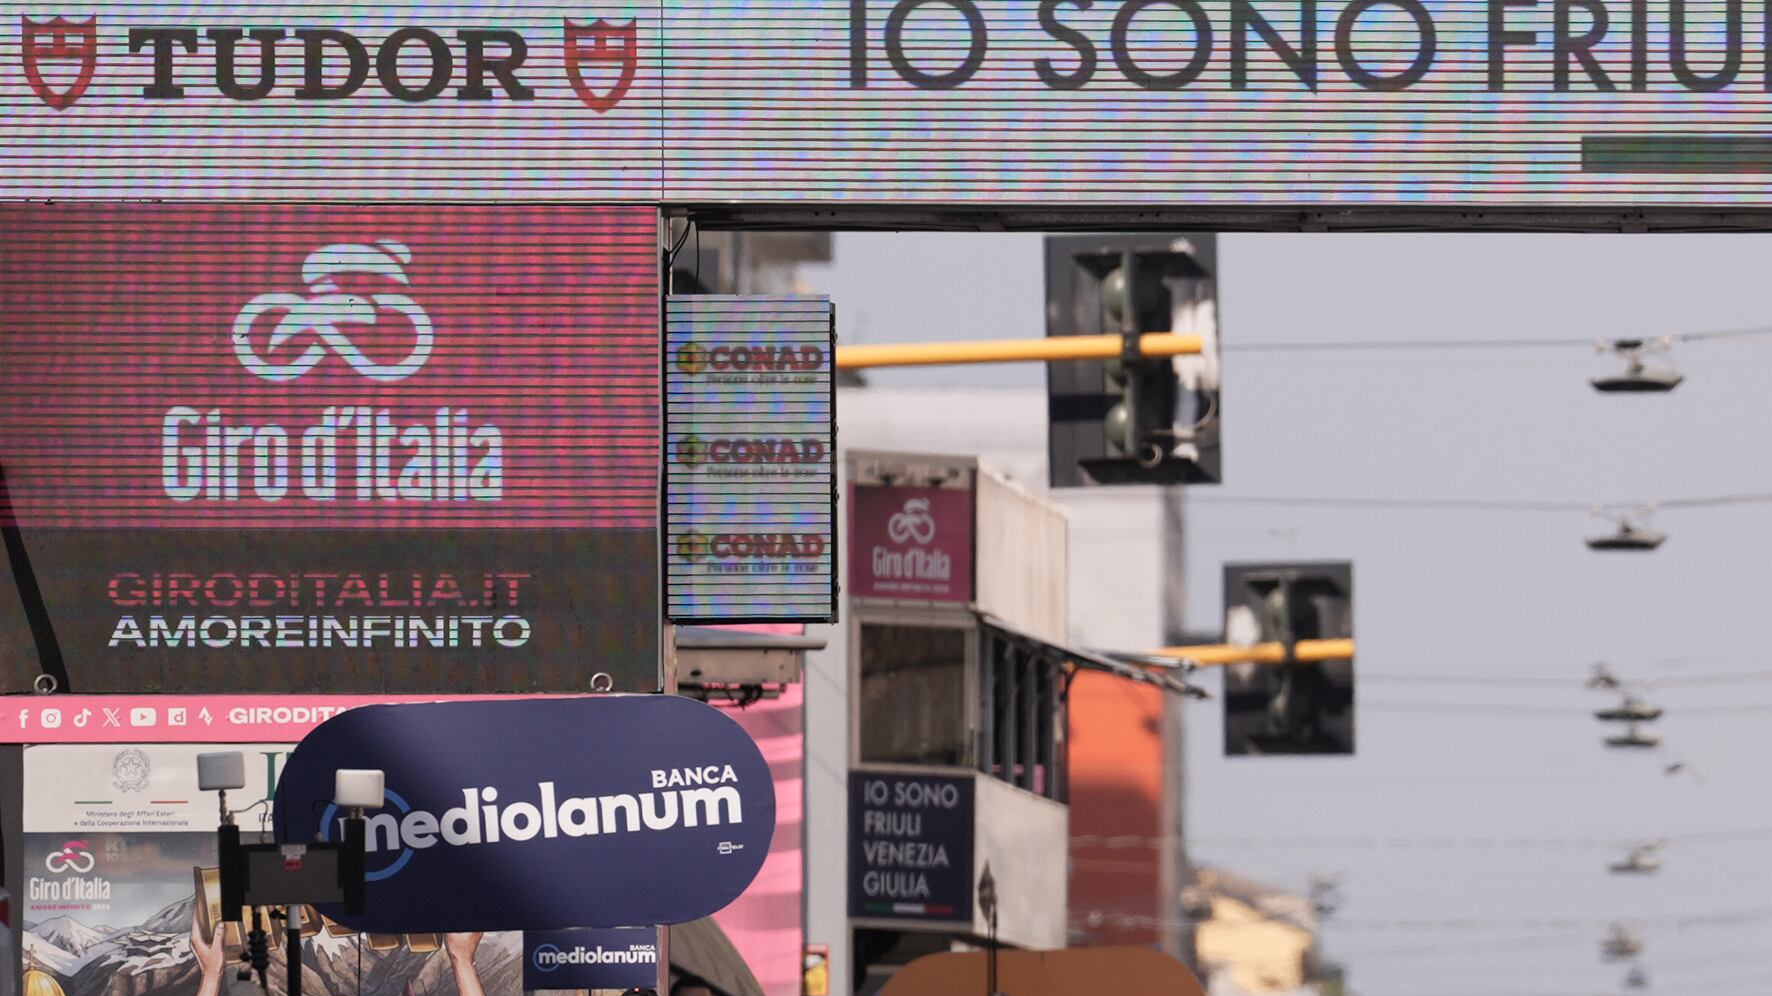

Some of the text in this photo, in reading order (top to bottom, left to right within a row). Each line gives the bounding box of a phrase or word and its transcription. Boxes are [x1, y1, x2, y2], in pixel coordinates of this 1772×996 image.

[850, 0, 987, 90] IO
[1034, 0, 1436, 93] SONO
[129, 26, 536, 102] TUDOR
[709, 345, 824, 371] CONAD
[162, 406, 504, 502] Giro d'Italia
[709, 438, 825, 463] CONAD
[709, 533, 825, 558] CONAD
[107, 573, 532, 607] GIRODITALIA.IT
[107, 615, 532, 649] AMOREINFINITO
[229, 706, 345, 725] GIRODIT
[651, 764, 739, 789] BANCA
[863, 780, 959, 809] IO SONO
[97, 819, 141, 828] Cooperazione
[142, 819, 189, 827] Internazionale
[338, 781, 743, 854] mediolanum
[864, 810, 922, 836] FRIULI
[862, 840, 950, 867] VENEZIA
[30, 877, 111, 900] Giro d'Italia
[862, 870, 930, 897] GIULIA
[538, 946, 656, 966] mediolanum
